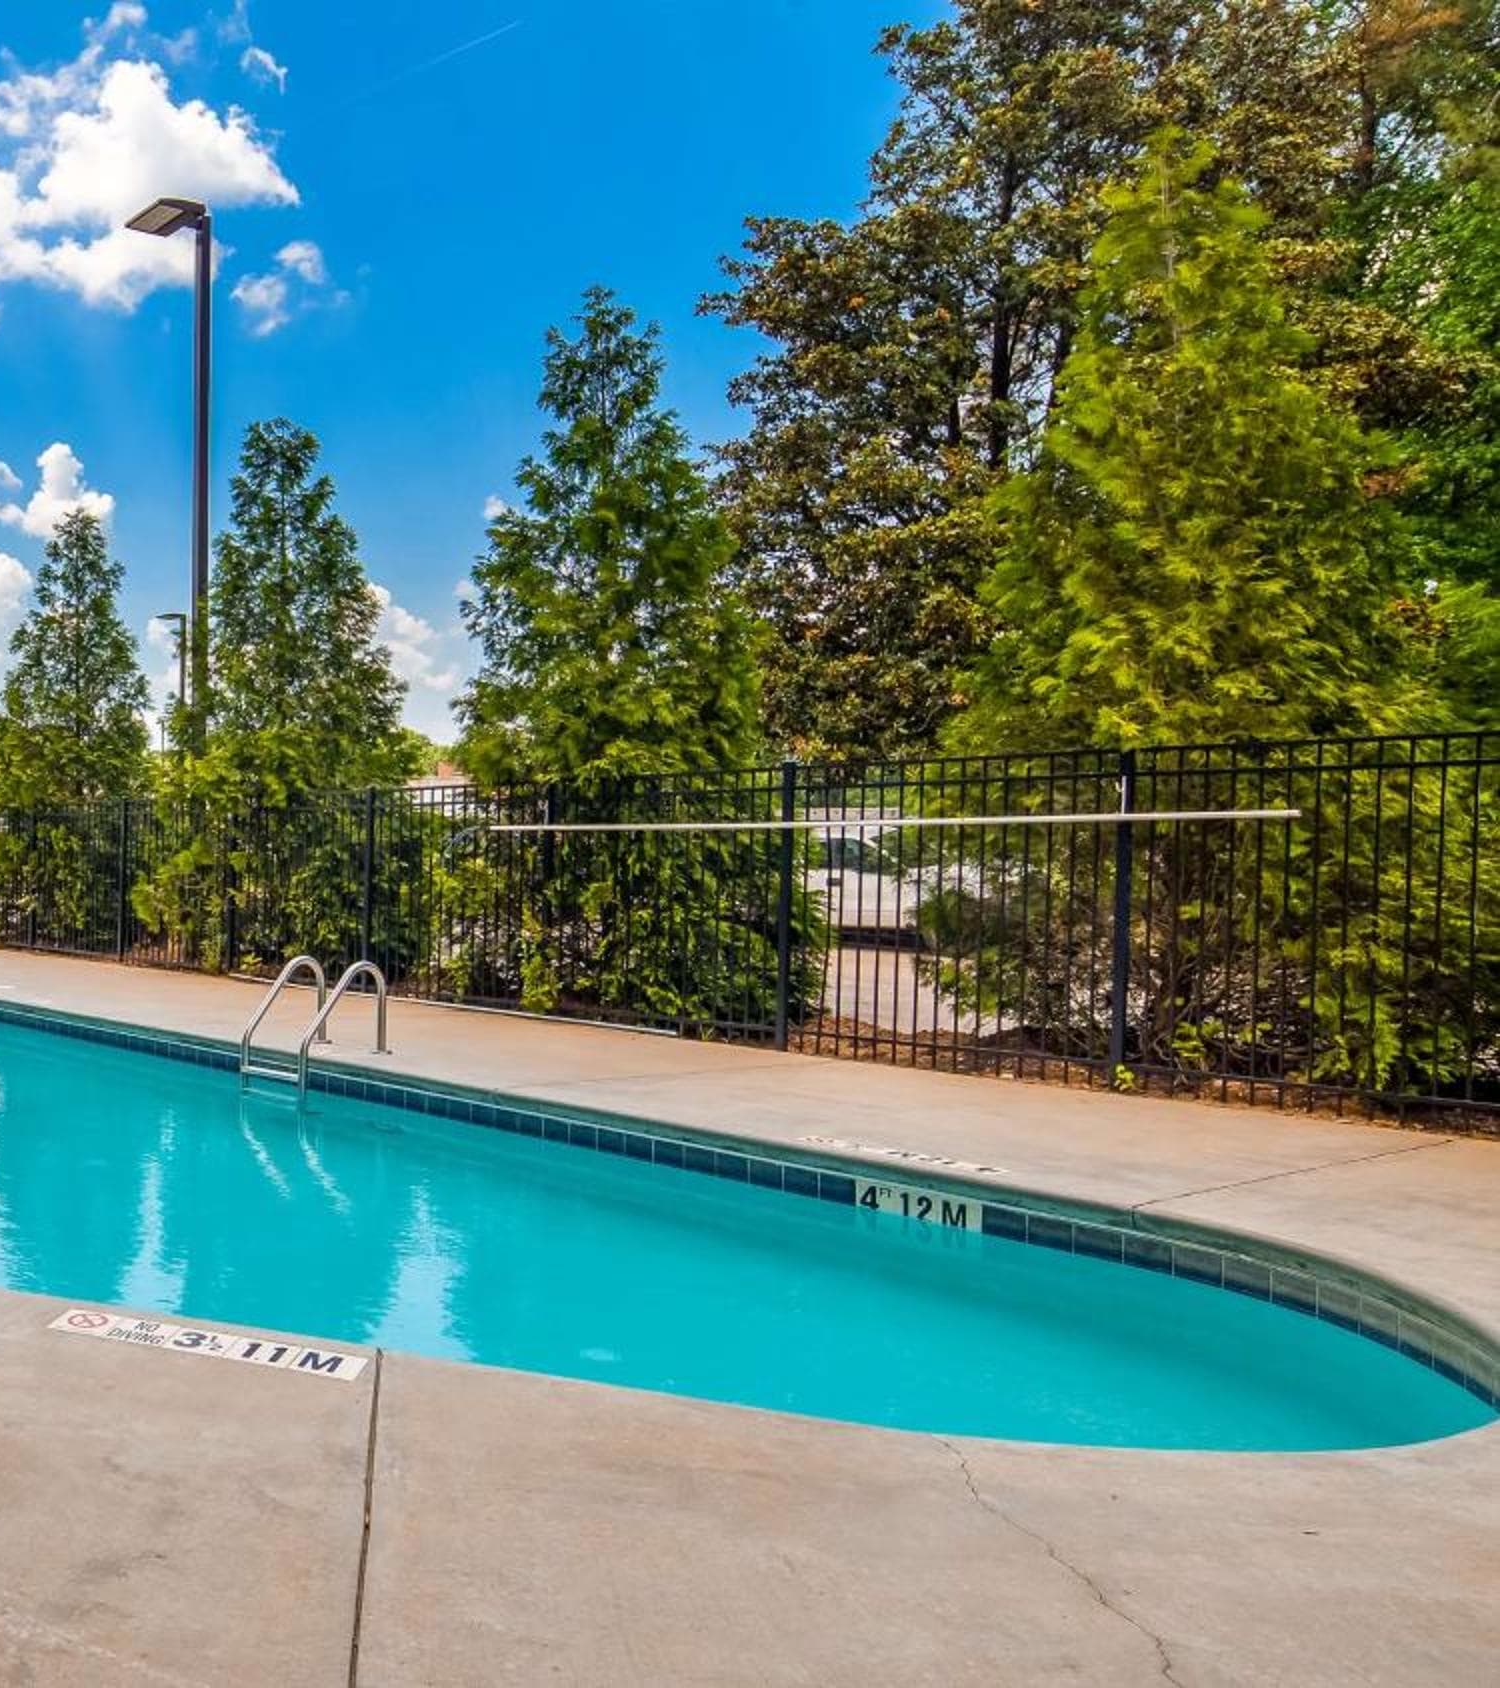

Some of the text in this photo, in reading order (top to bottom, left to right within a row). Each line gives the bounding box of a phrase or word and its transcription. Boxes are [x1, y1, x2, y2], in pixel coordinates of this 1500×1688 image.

[942, 1200, 967, 1228] M
[106, 1327, 165, 1345] DIVING
[133, 1321, 161, 1333] NO
[298, 1351, 344, 1373] M
